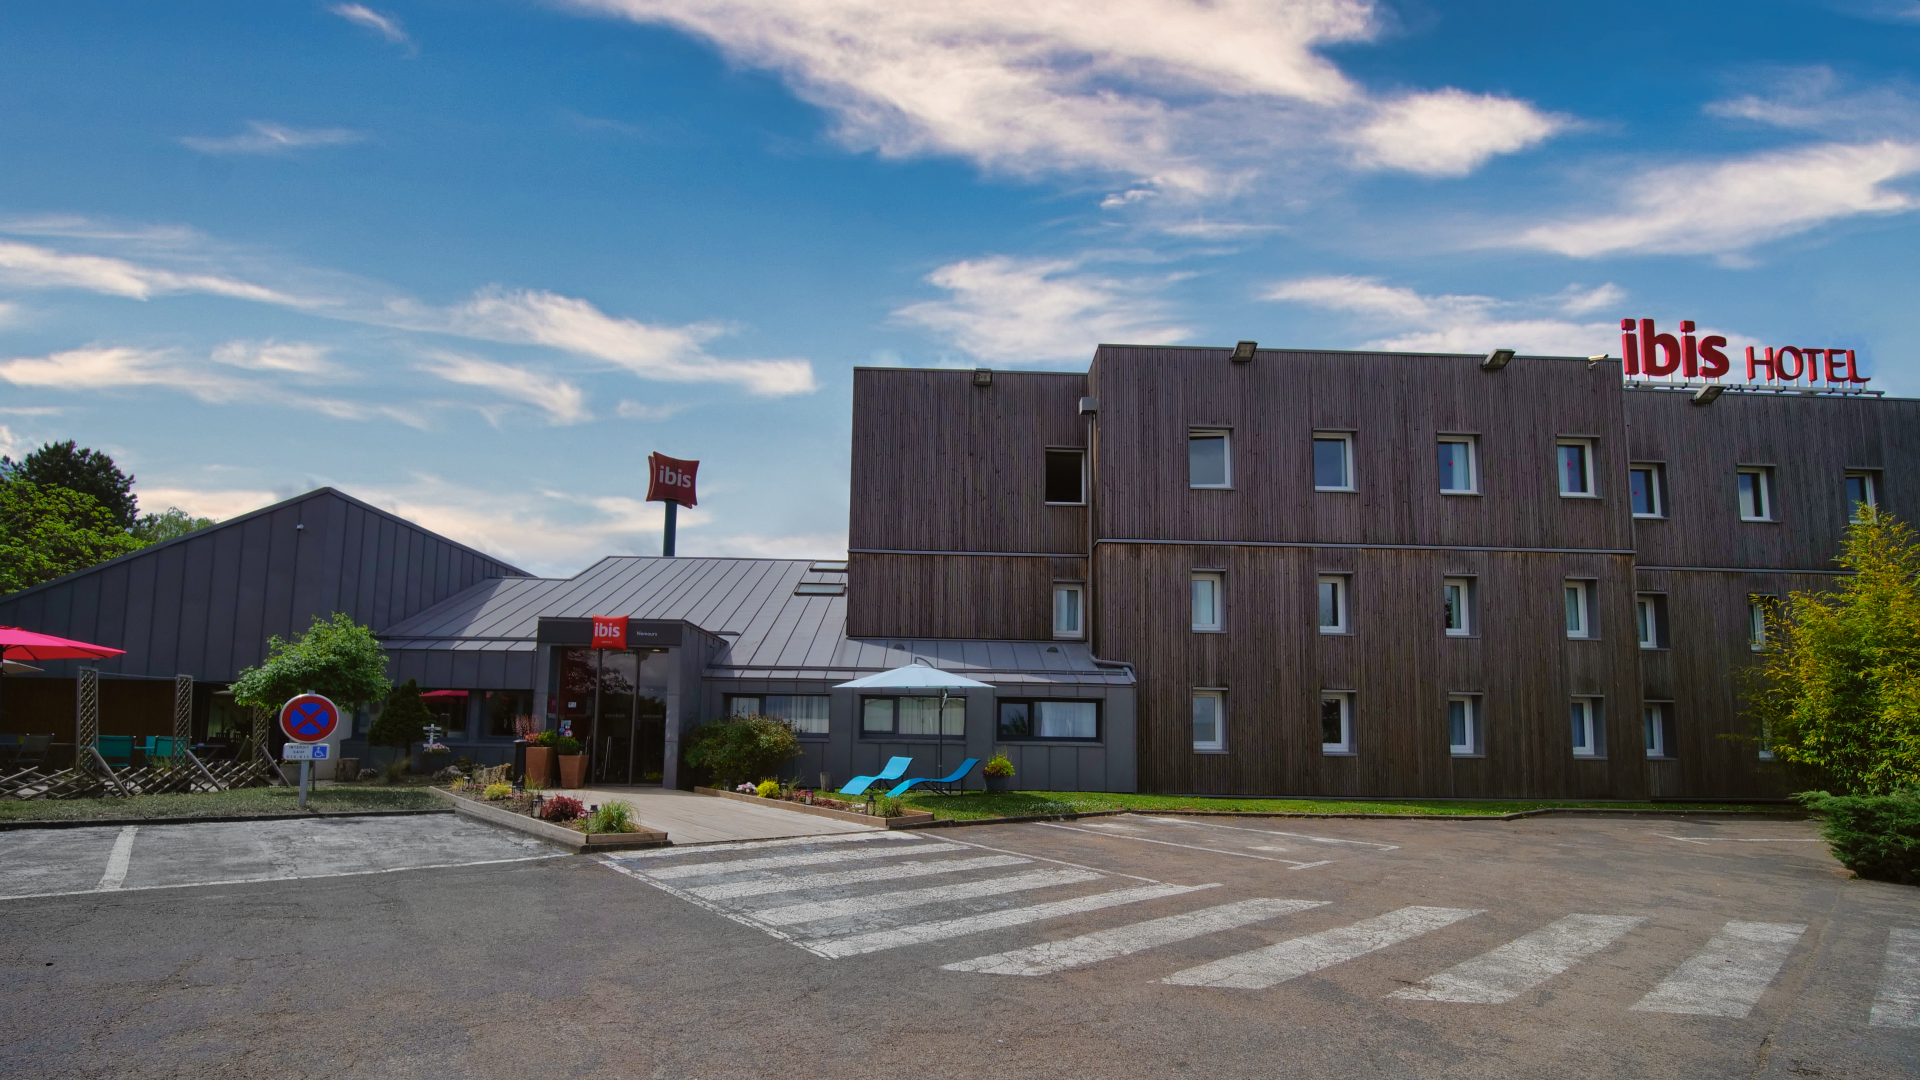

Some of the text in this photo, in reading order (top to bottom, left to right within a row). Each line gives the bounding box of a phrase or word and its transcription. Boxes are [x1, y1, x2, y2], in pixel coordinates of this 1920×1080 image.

[1620, 318, 1871, 383] ibis HOTEL
[659, 465, 691, 488] ibis
[594, 622, 620, 638] ibis
